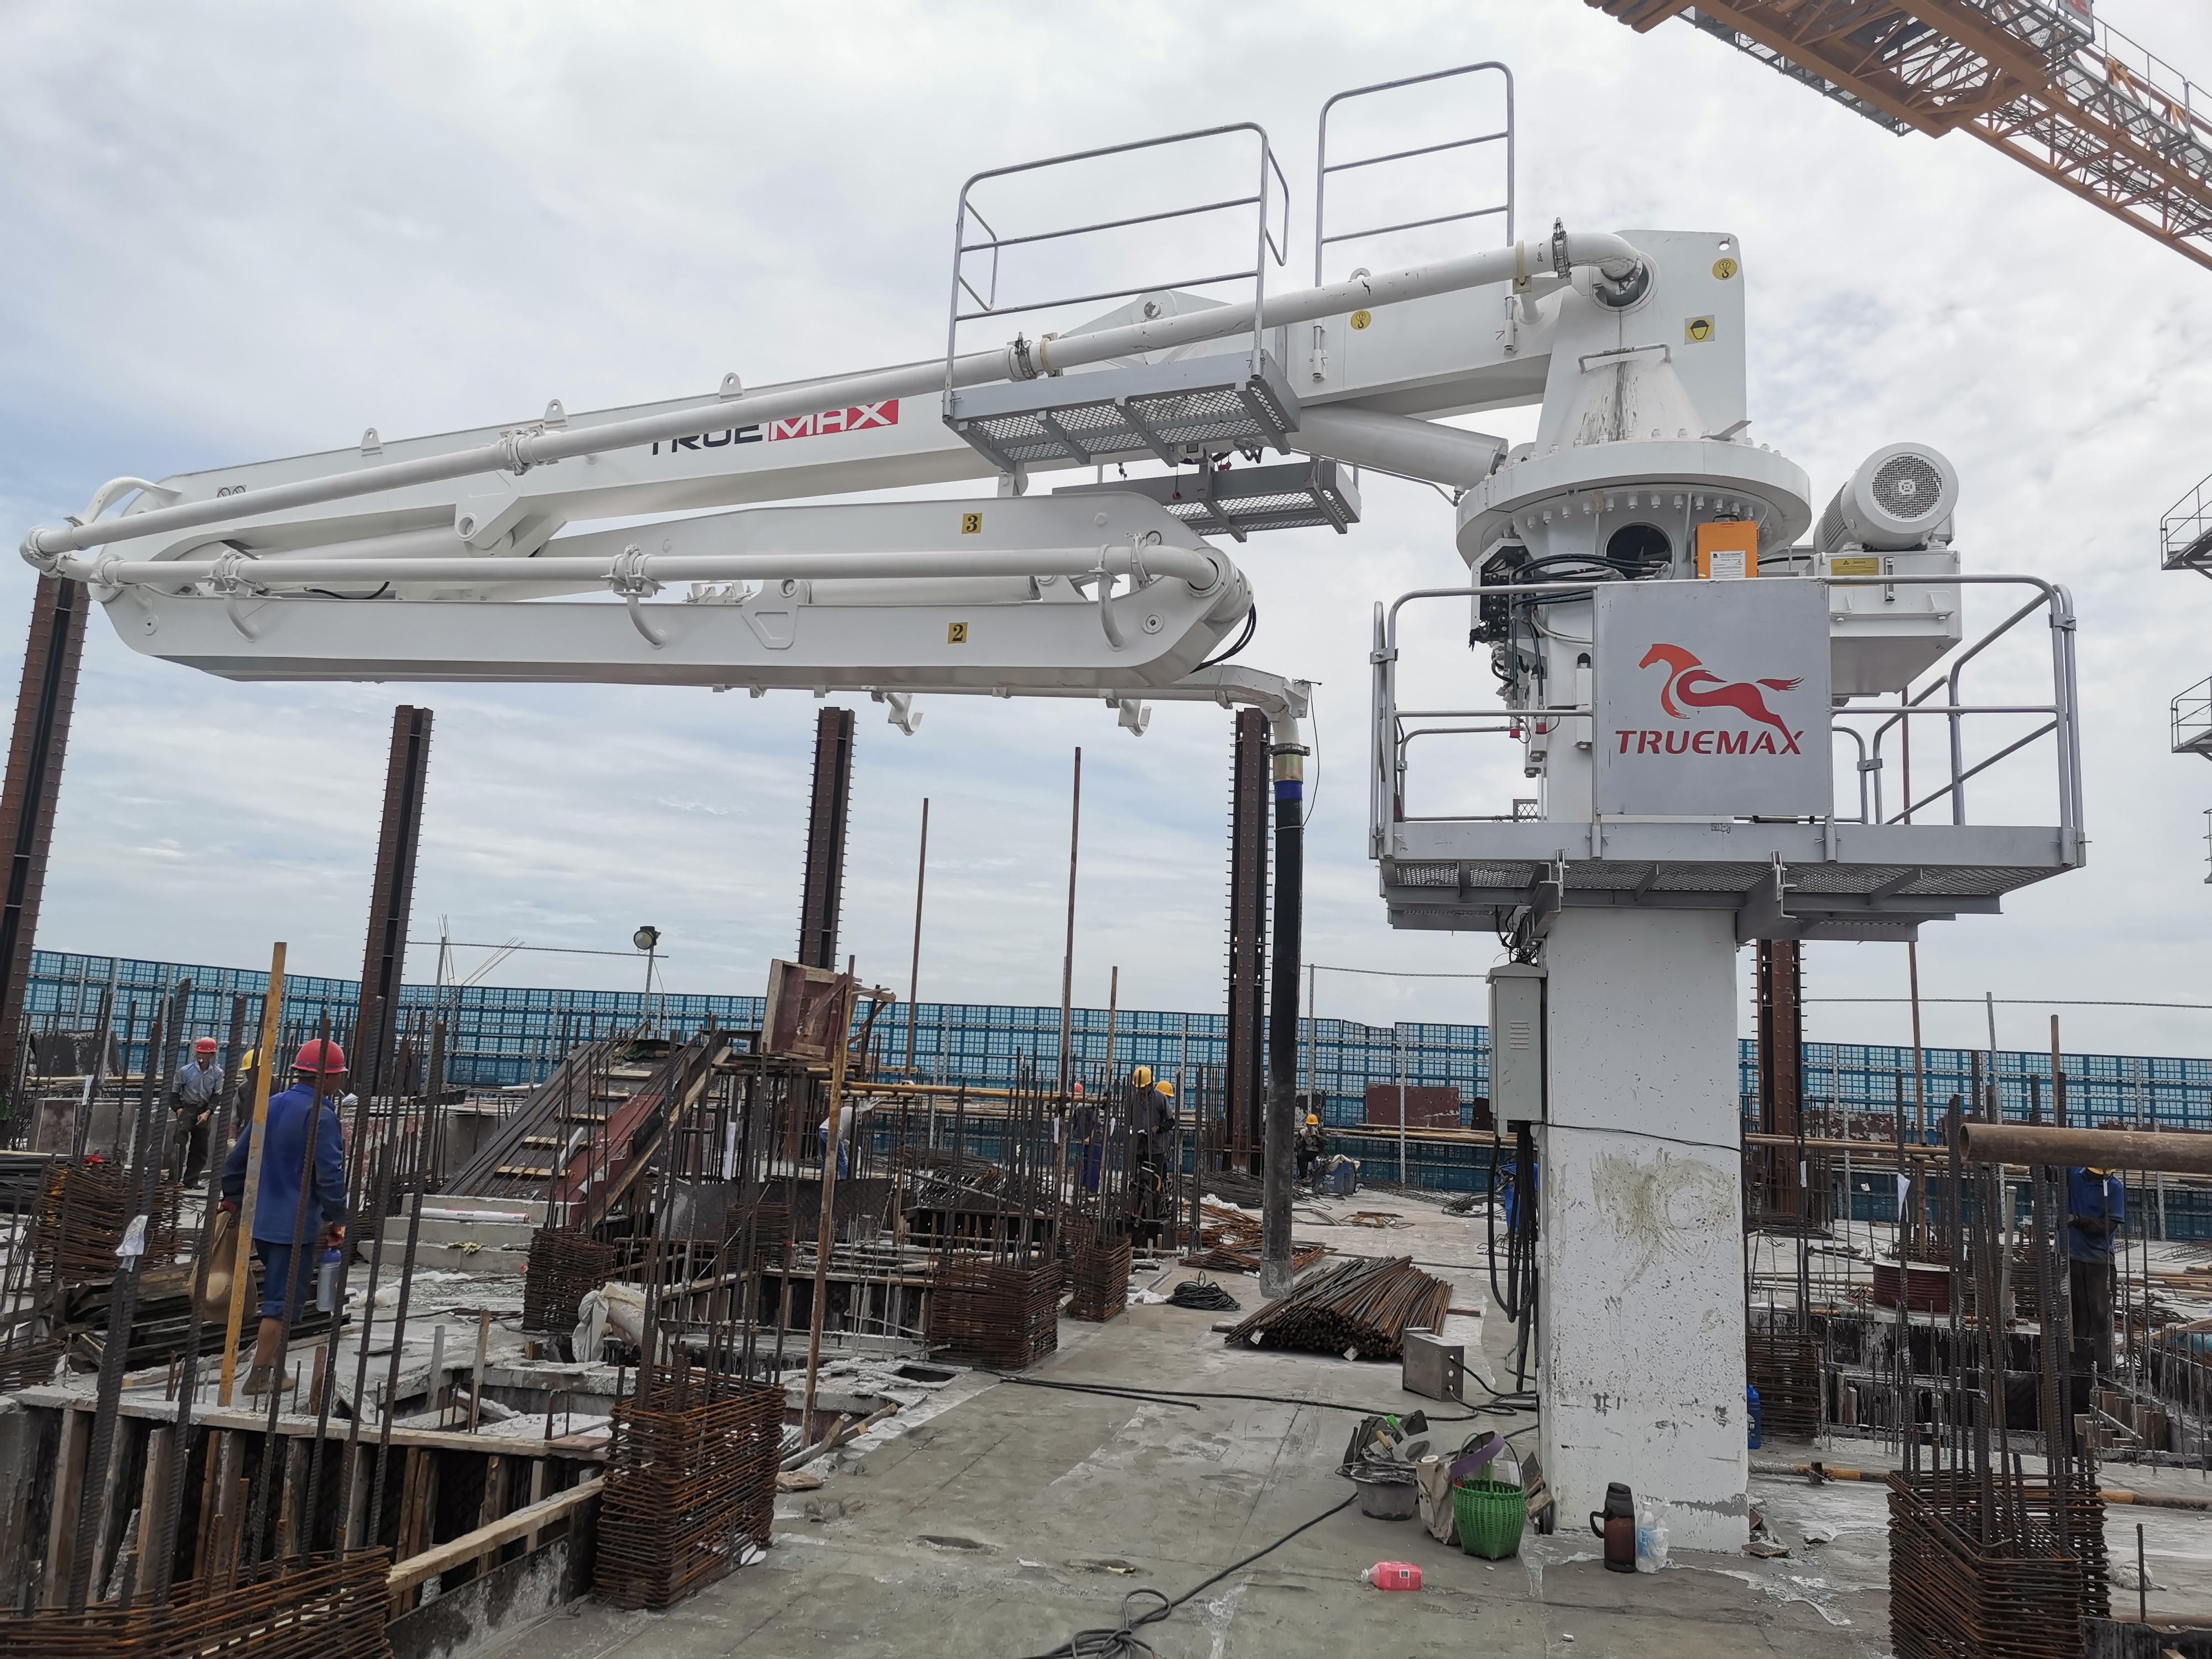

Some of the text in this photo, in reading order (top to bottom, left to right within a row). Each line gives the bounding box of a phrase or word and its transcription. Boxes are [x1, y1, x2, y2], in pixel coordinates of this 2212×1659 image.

[966, 515, 978, 532] 3
[952, 624, 963, 641] 2
[1615, 730, 1804, 755] TRUEMAX
